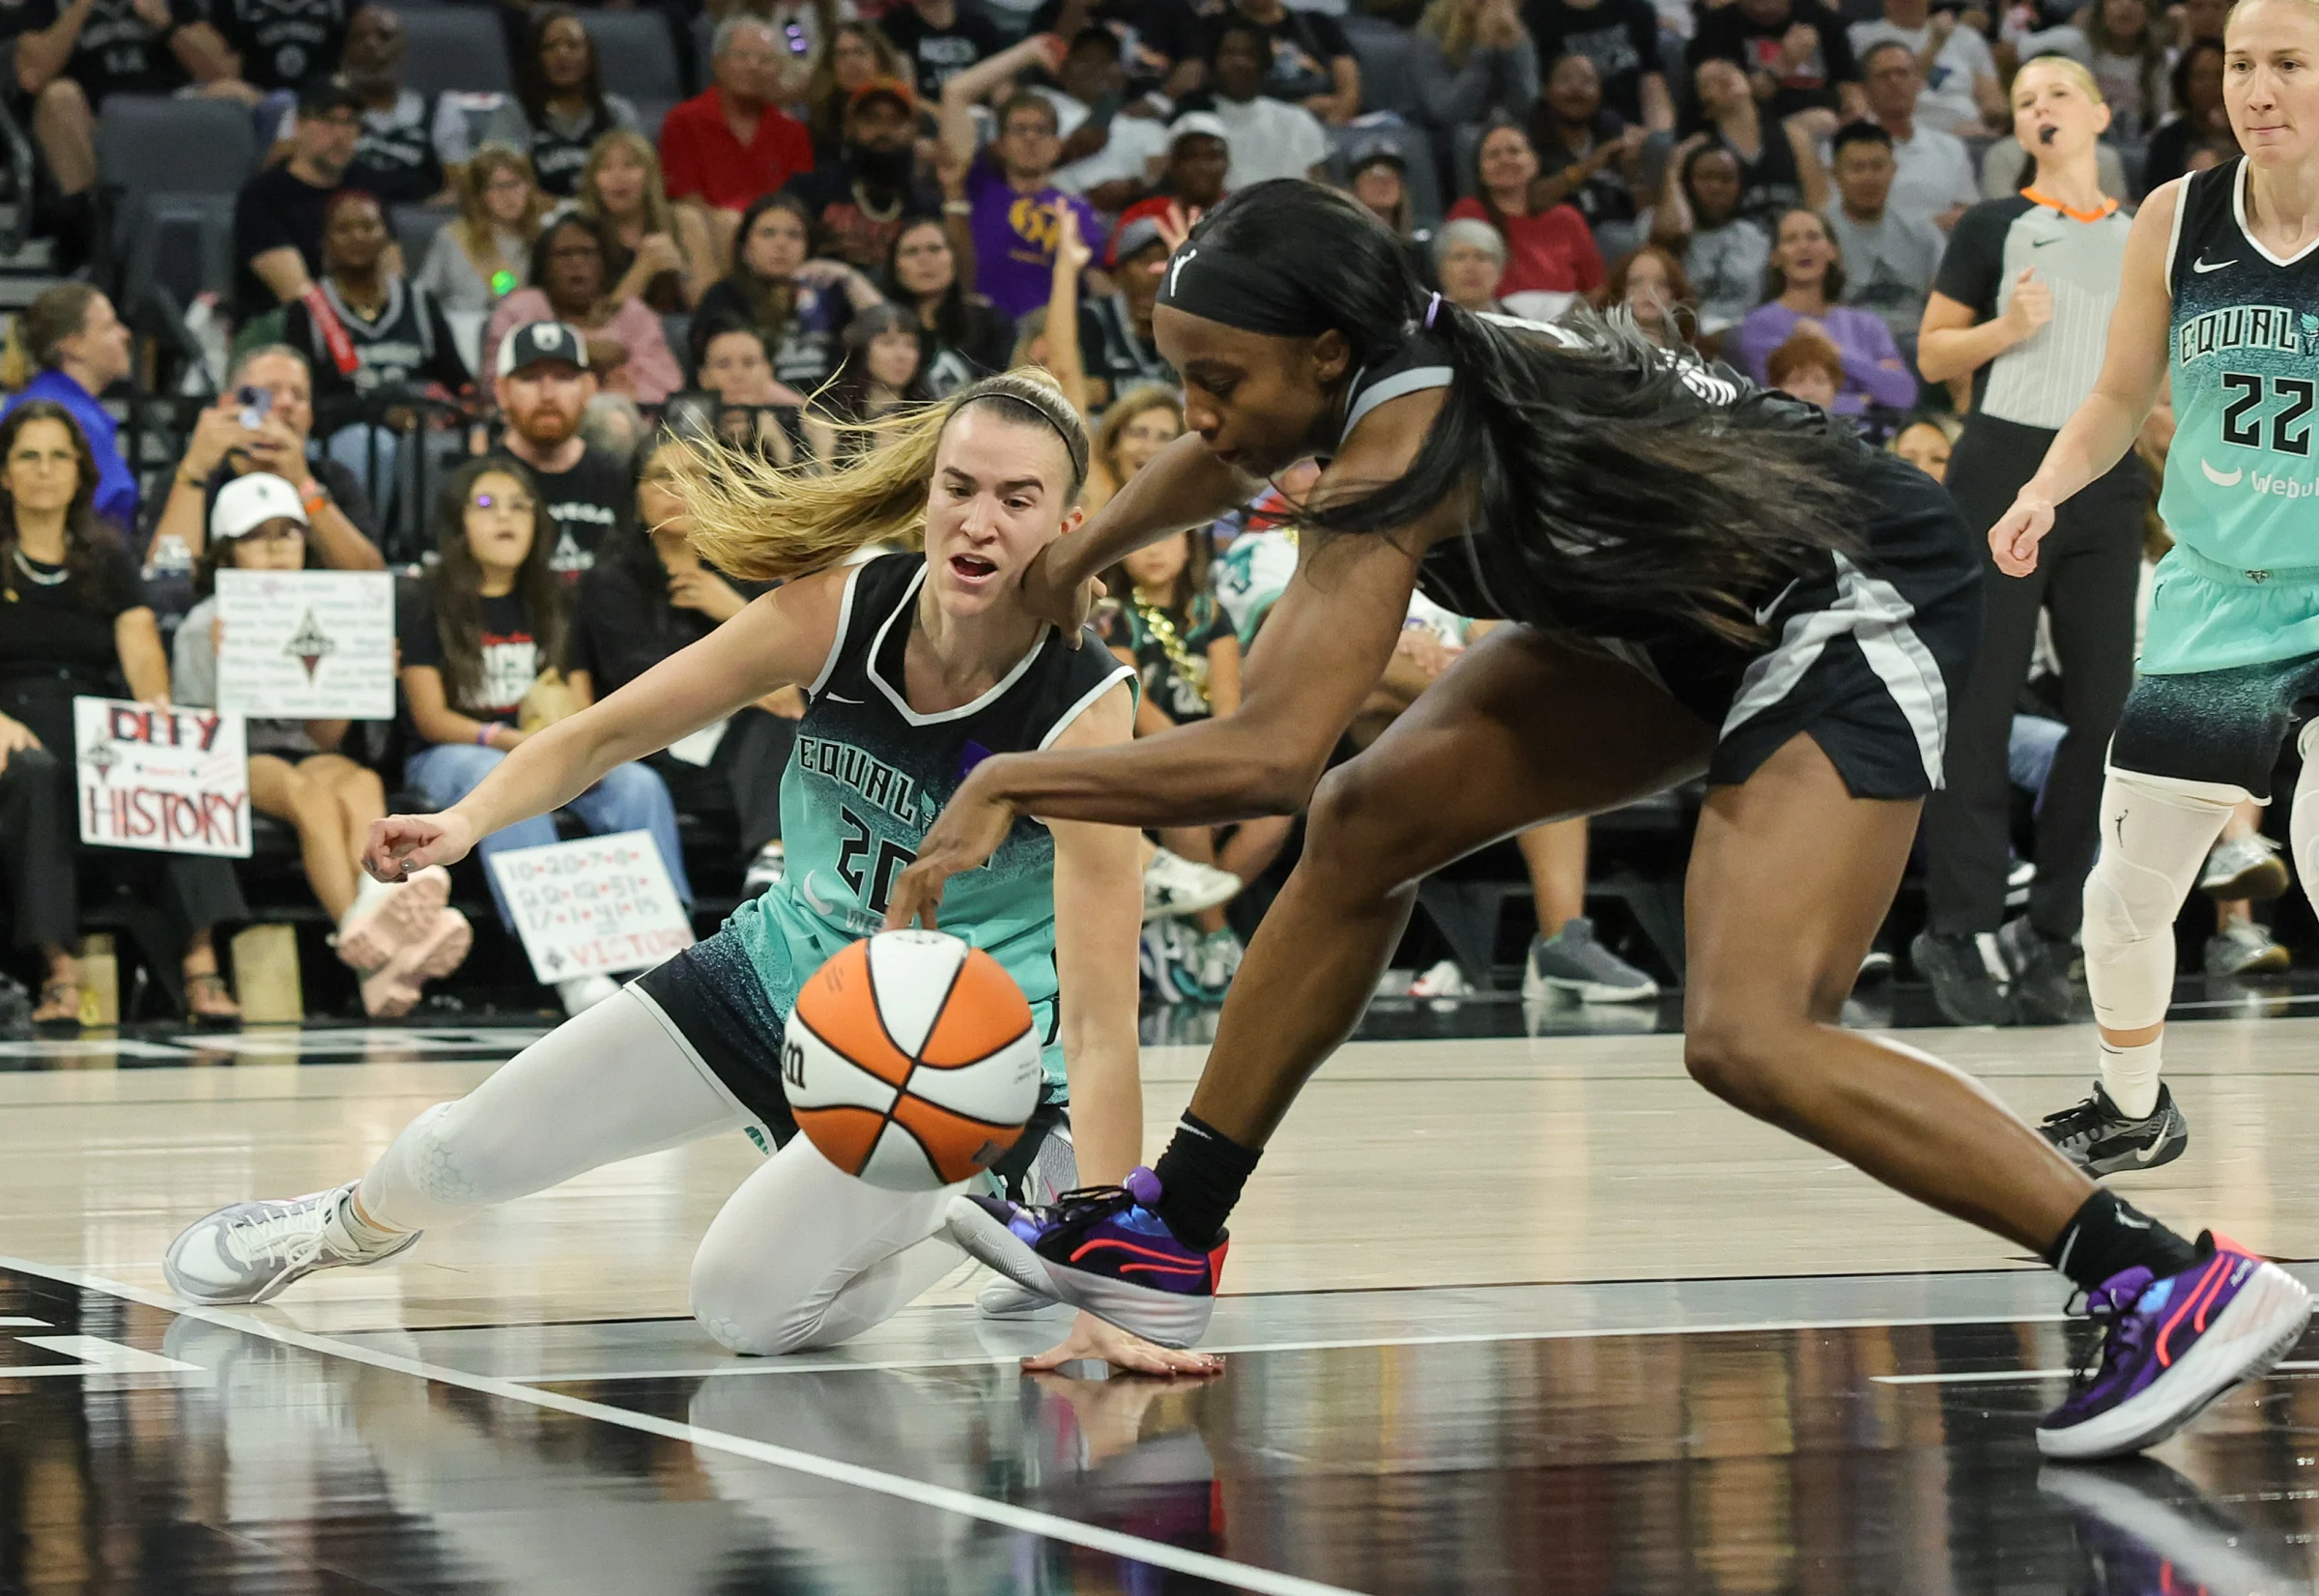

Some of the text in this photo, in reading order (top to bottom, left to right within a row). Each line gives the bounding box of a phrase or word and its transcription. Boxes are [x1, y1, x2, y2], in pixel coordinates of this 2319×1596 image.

[2220, 371, 2316, 458] 22
[110, 707, 221, 752] DEFY
[88, 784, 247, 848] HISTORY
